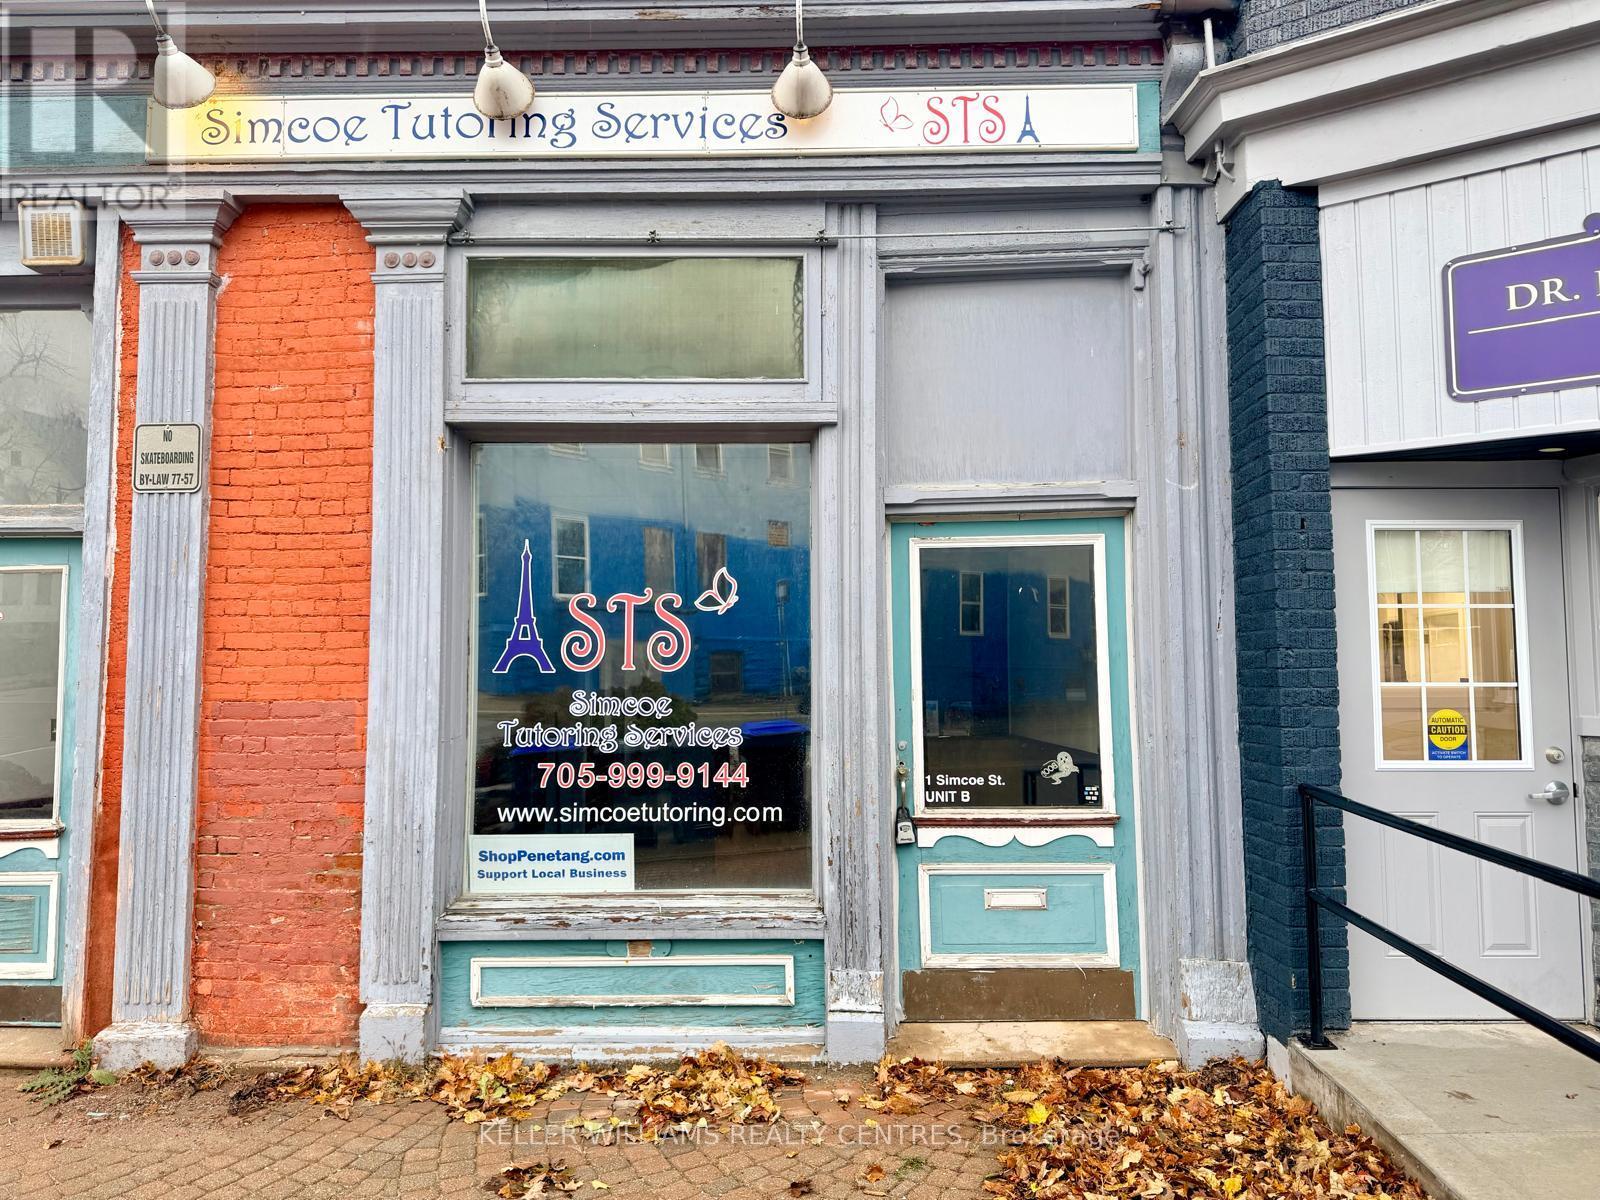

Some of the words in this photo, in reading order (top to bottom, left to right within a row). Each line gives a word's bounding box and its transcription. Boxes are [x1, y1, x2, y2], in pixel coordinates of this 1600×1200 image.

[201, 108, 369, 146] Simcoe
[591, 102, 788, 144] Services
[922, 92, 1006, 145] STS
[1505, 277, 1581, 311] DR.
[163, 429, 173, 442] NO
[140, 451, 194, 465] SKATEBOARDING
[139, 473, 170, 486] BY-LAW
[172, 473, 194, 484] 77-57
[560, 587, 692, 673] STS
[569, 689, 673, 720] Simcoe
[497, 718, 619, 754] Tutoring
[624, 721, 743, 750] Services
[1431, 726, 1466, 734] CAUTION
[537, 762, 750, 789] 705-999-9144
[925, 774, 932, 786] 1
[936, 774, 985, 786] Simcoe
[987, 774, 1006, 786] St.
[925, 790, 957, 803] UNIT
[960, 790, 971, 803] B
[497, 802, 783, 827] www.simcoetutoring.com
[478, 850, 626, 864] ShopPenetang.com
[477, 869, 528, 881] Support
[531, 869, 566, 879] Local
[569, 868, 628, 879] Business
